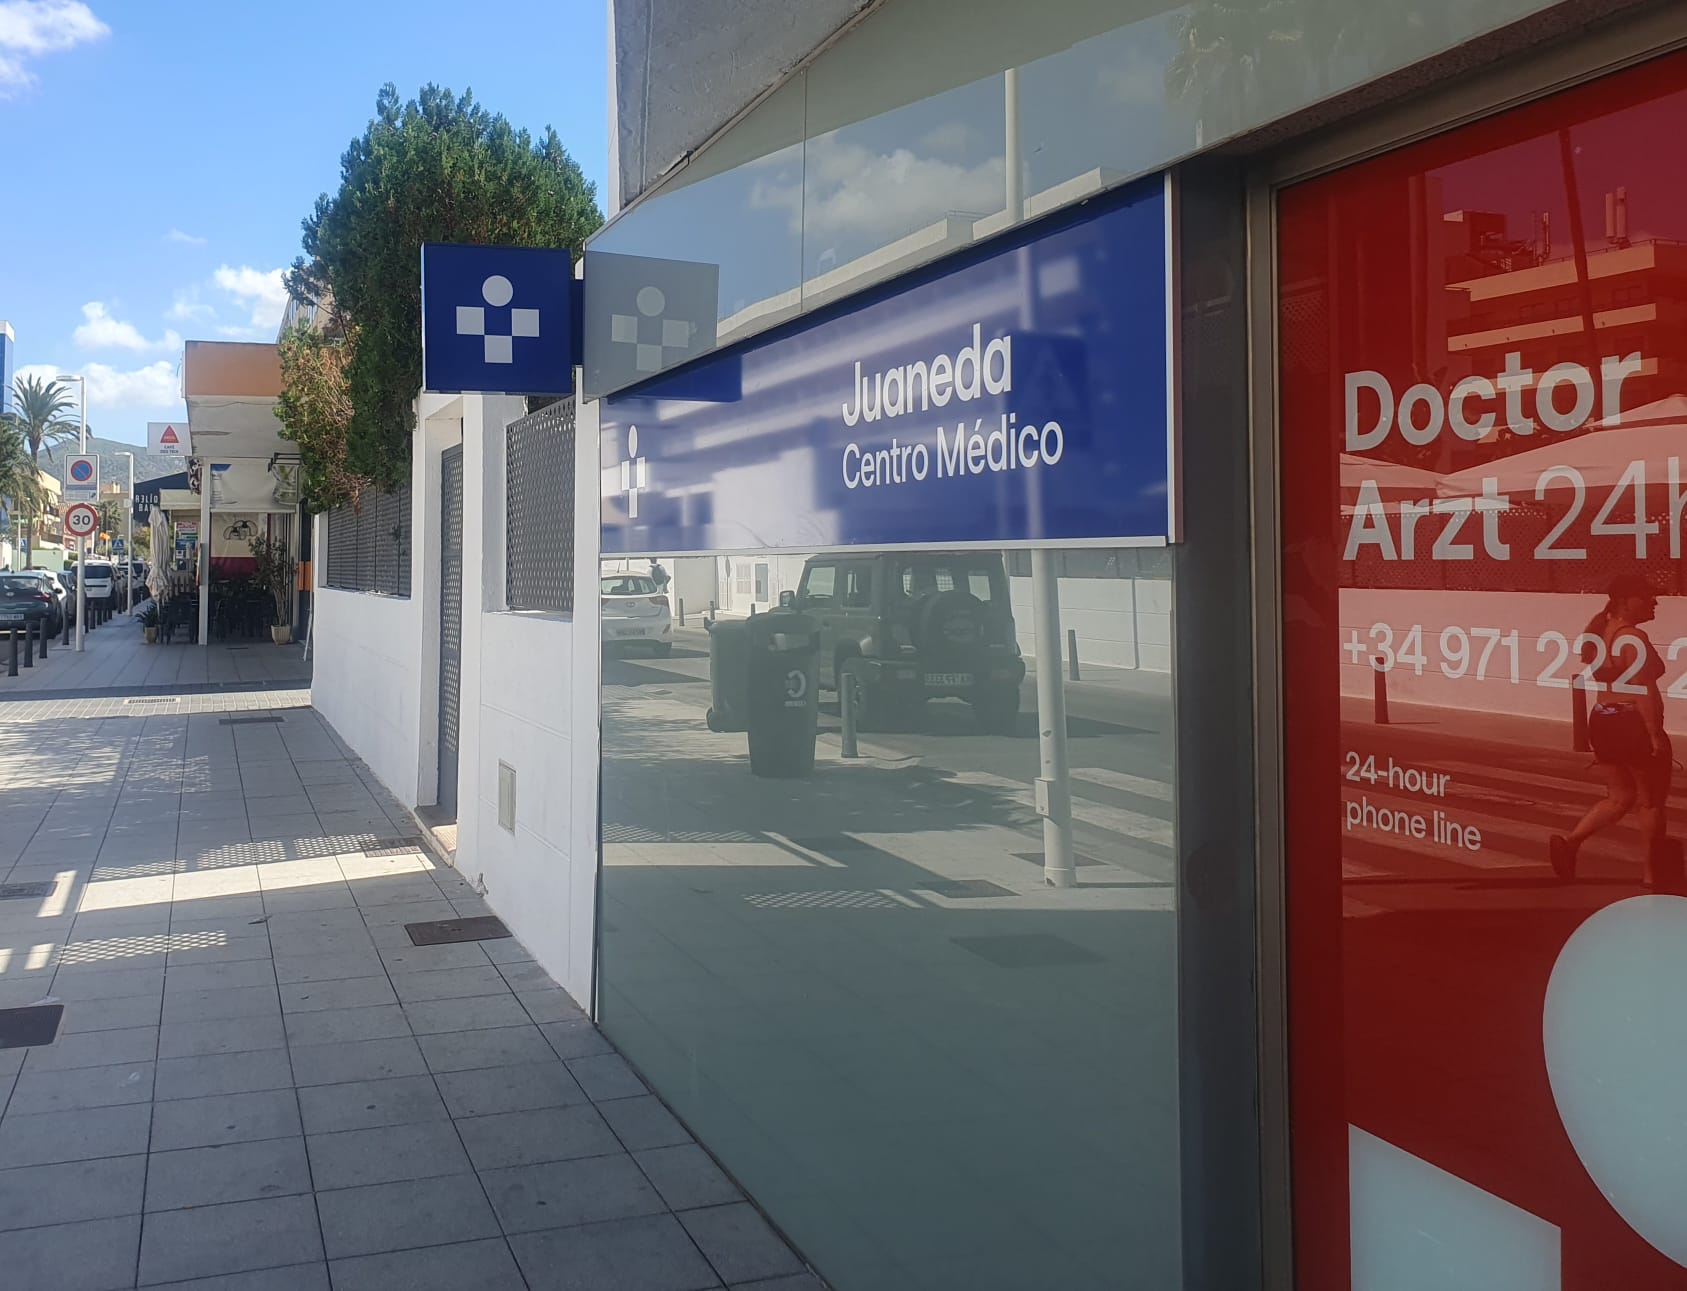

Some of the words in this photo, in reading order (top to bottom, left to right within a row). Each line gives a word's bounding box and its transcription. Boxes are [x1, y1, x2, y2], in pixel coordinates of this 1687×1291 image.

[842, 322, 1012, 427] Juaneda
[1345, 351, 1642, 452] Doctor
[842, 438, 929, 489] Centro
[937, 412, 1064, 479] Médico
[72, 514, 91, 526] 30
[1342, 477, 1510, 561] Arzt
[1343, 622, 1427, 676] +34
[1439, 626, 1520, 684] 971
[1536, 630, 1648, 695] 222
[1345, 751, 1451, 797] 24-hour
[1346, 796, 1427, 840] phone
[1433, 810, 1483, 852] line
